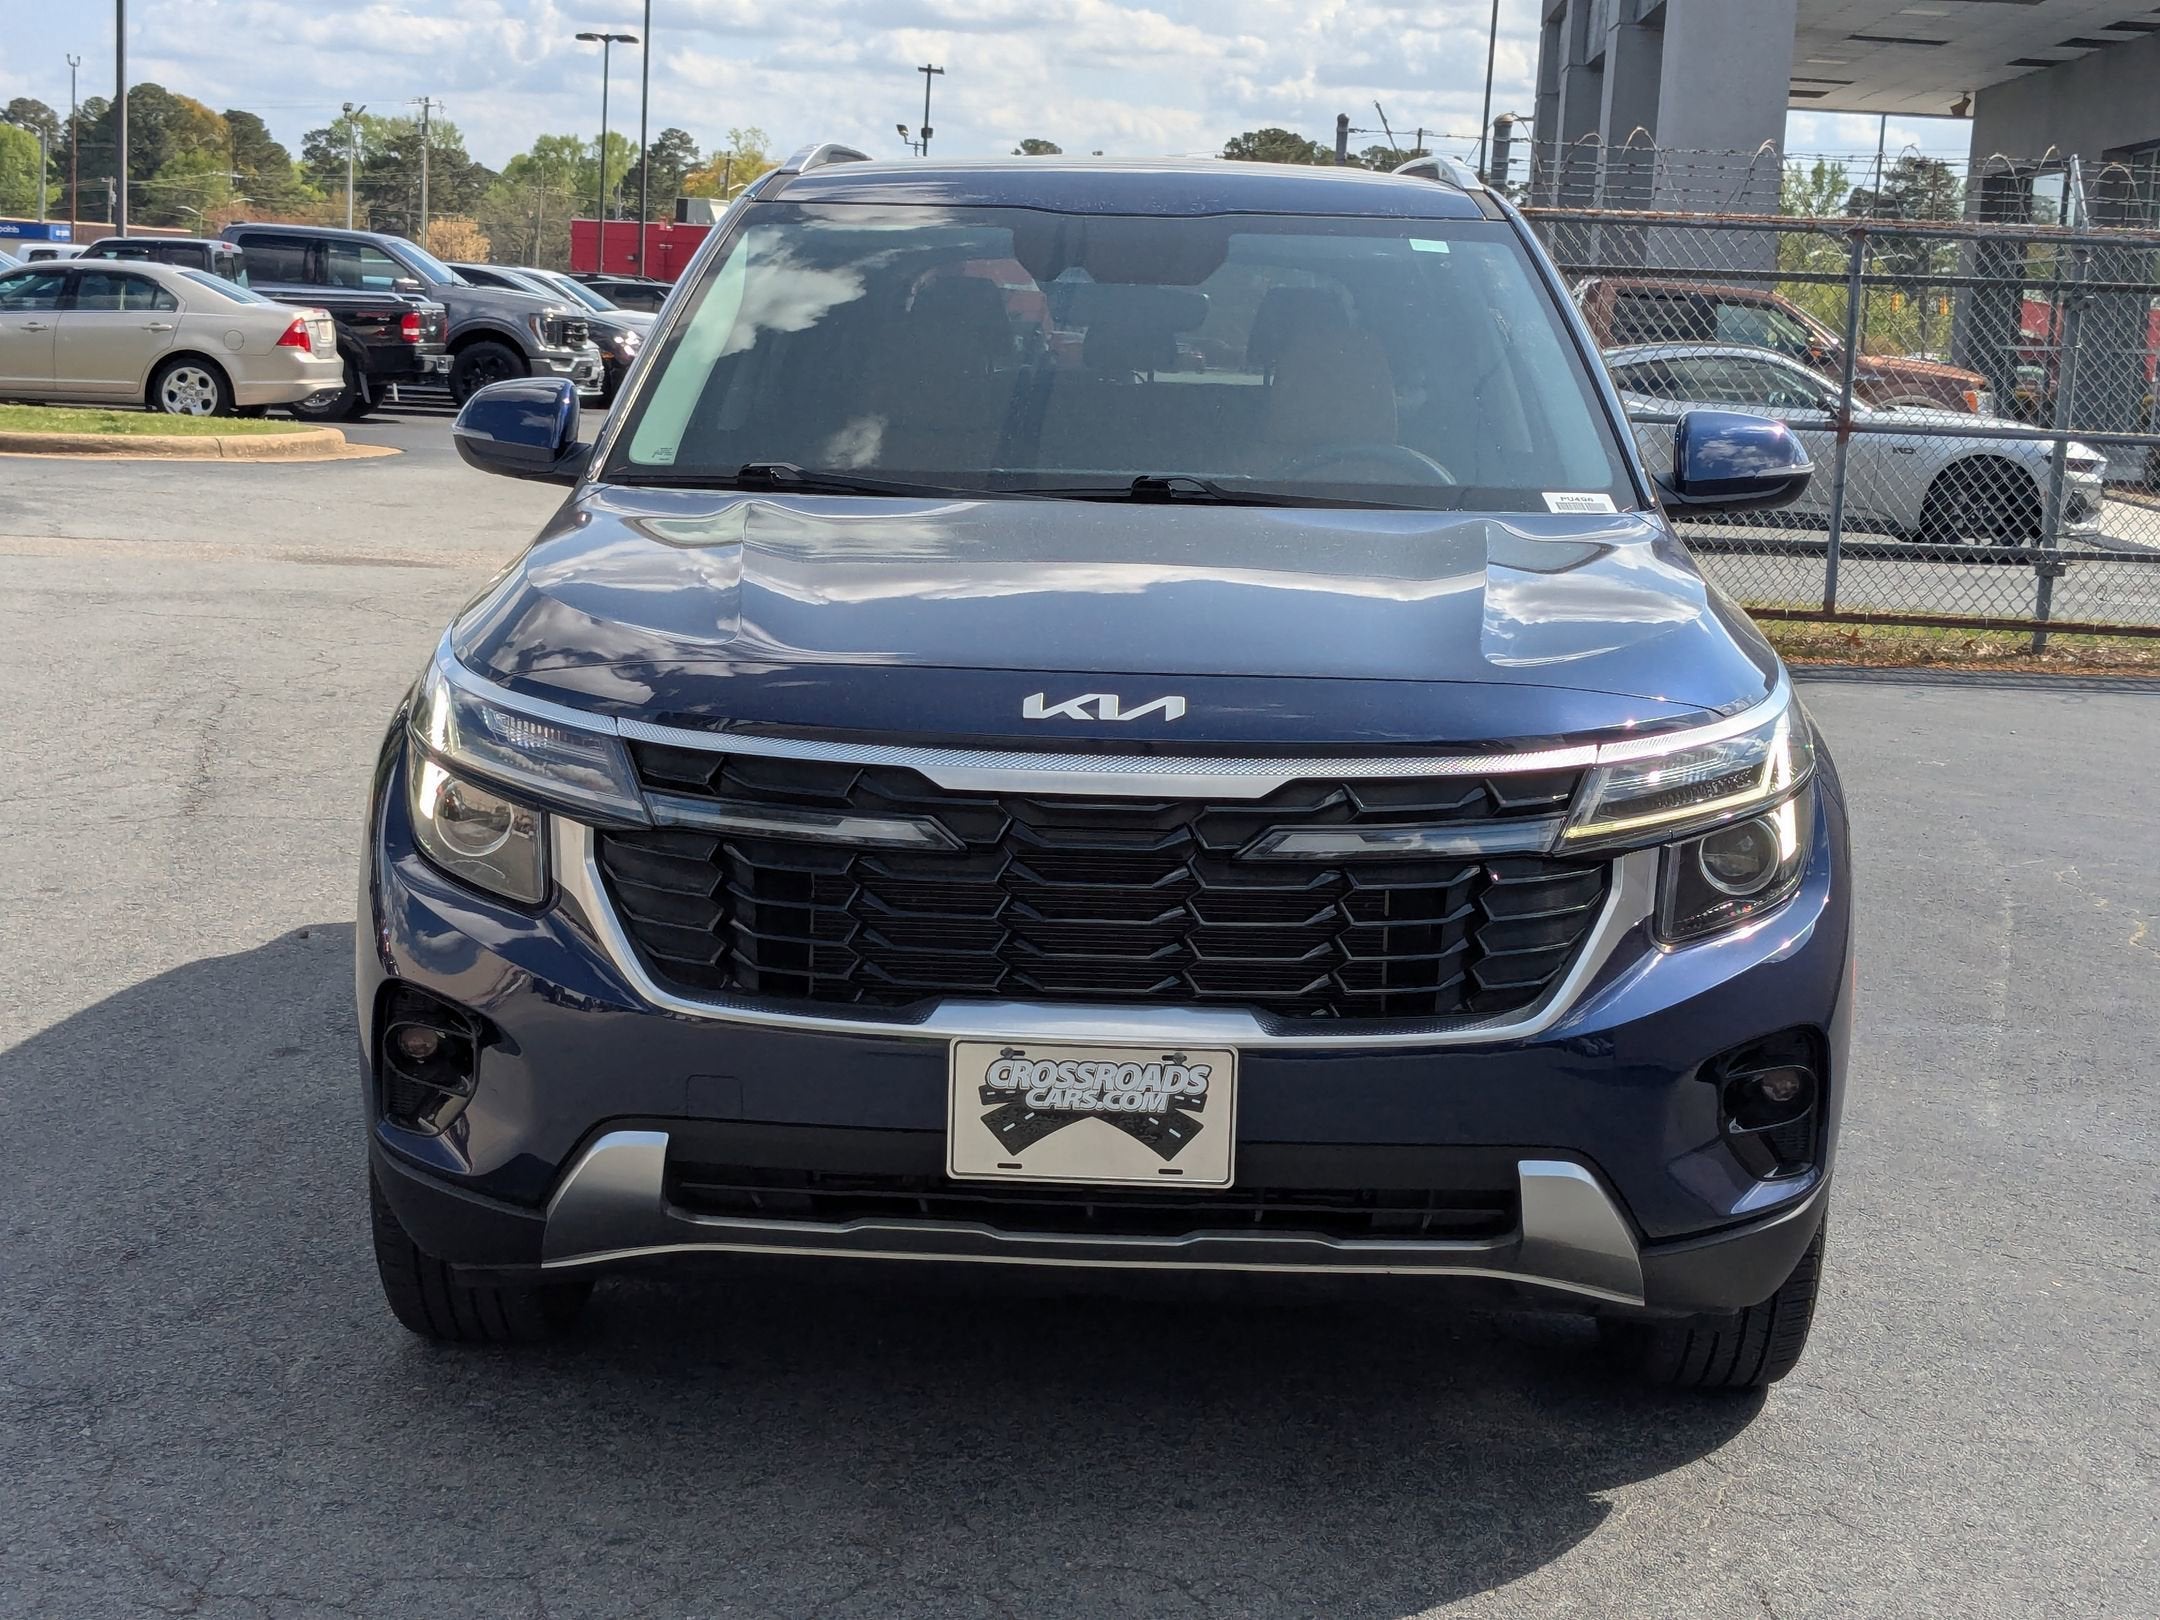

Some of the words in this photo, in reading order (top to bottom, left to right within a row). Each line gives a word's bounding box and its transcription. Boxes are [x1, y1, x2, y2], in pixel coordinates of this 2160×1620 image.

[1023, 692, 1185, 721] KIA
[986, 1059, 1211, 1095] CROSSROADS
[1025, 1089, 1169, 1113] CARS.COM
